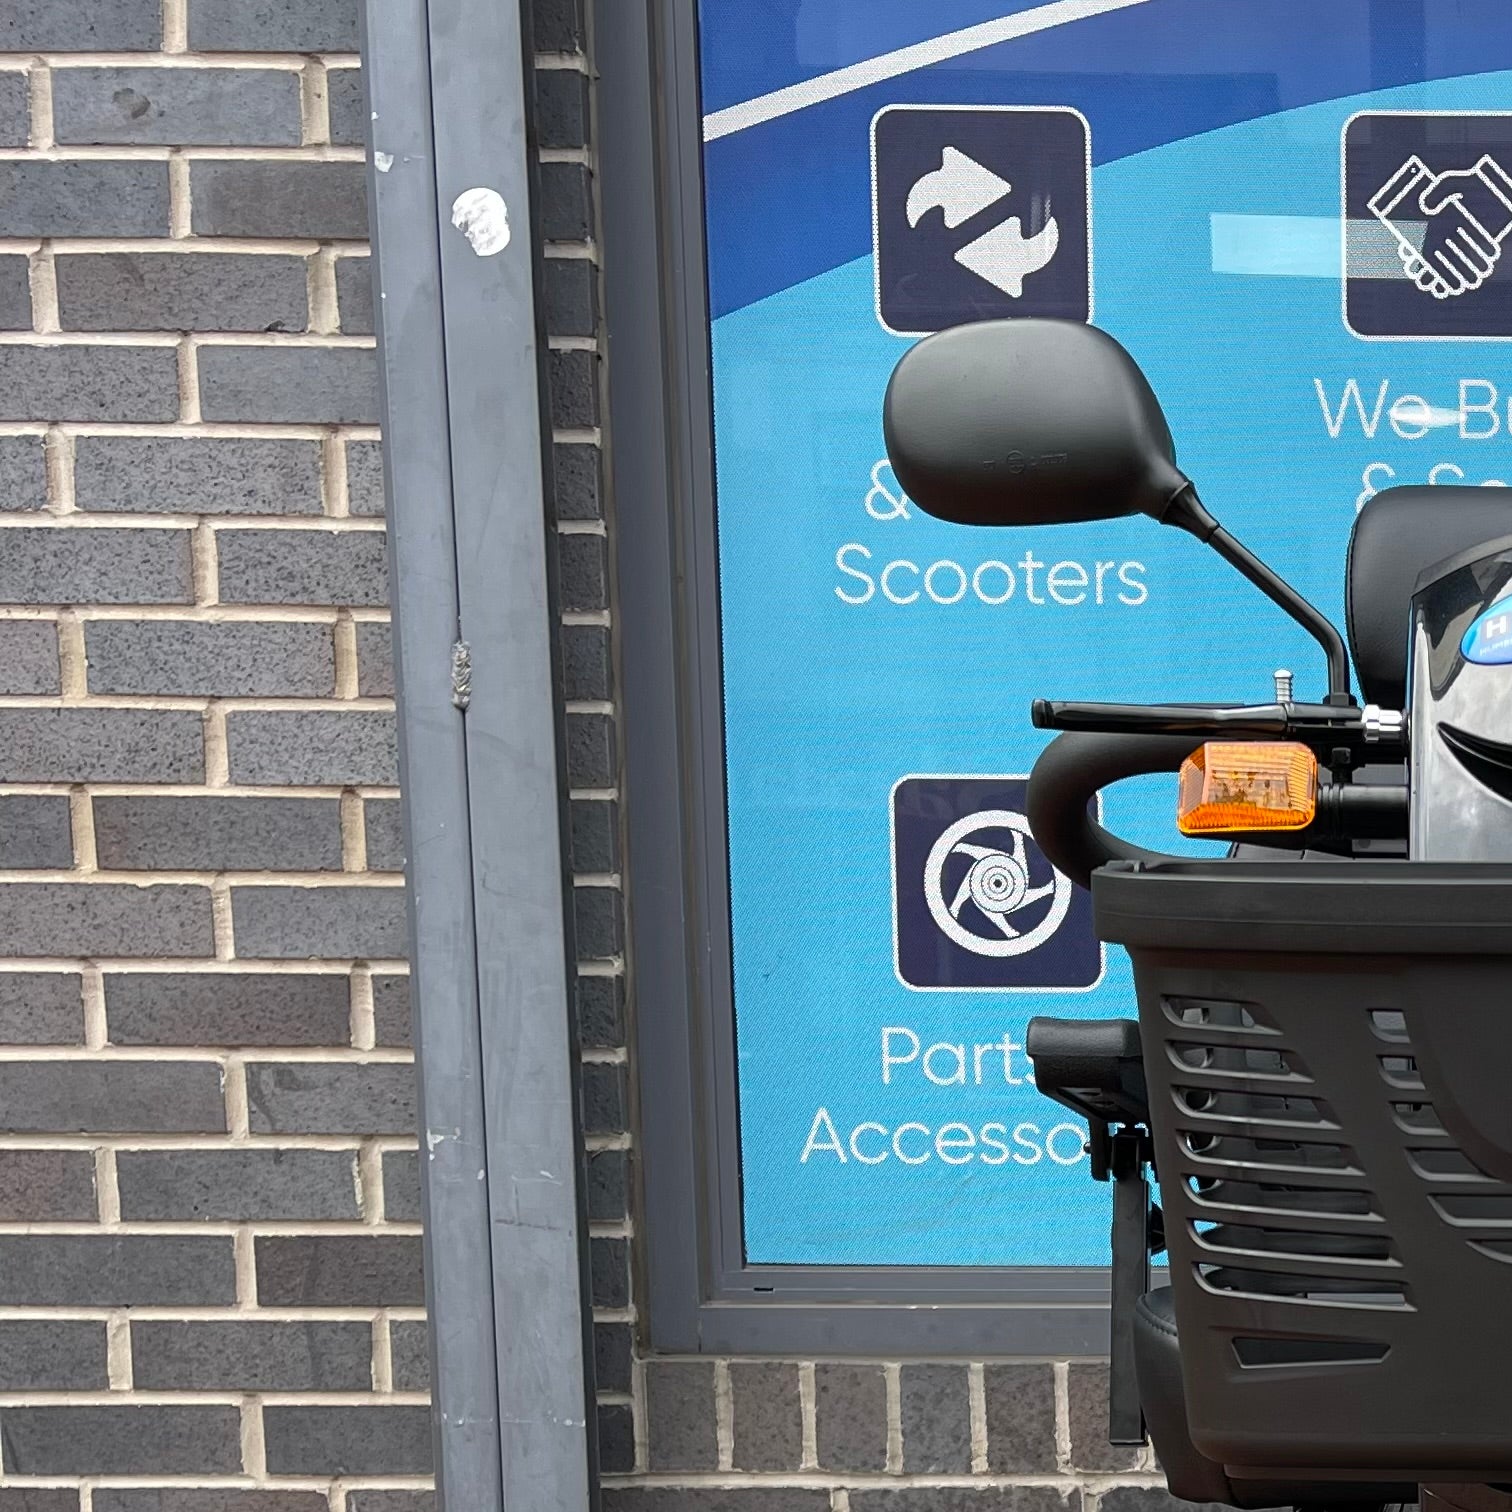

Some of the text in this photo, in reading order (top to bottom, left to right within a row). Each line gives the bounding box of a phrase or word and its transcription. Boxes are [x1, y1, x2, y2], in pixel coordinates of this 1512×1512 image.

[1313, 378, 1432, 440] We
[864, 459, 912, 520] &
[834, 543, 1149, 605] Scooters
[800, 1107, 1089, 1165] Accesso
